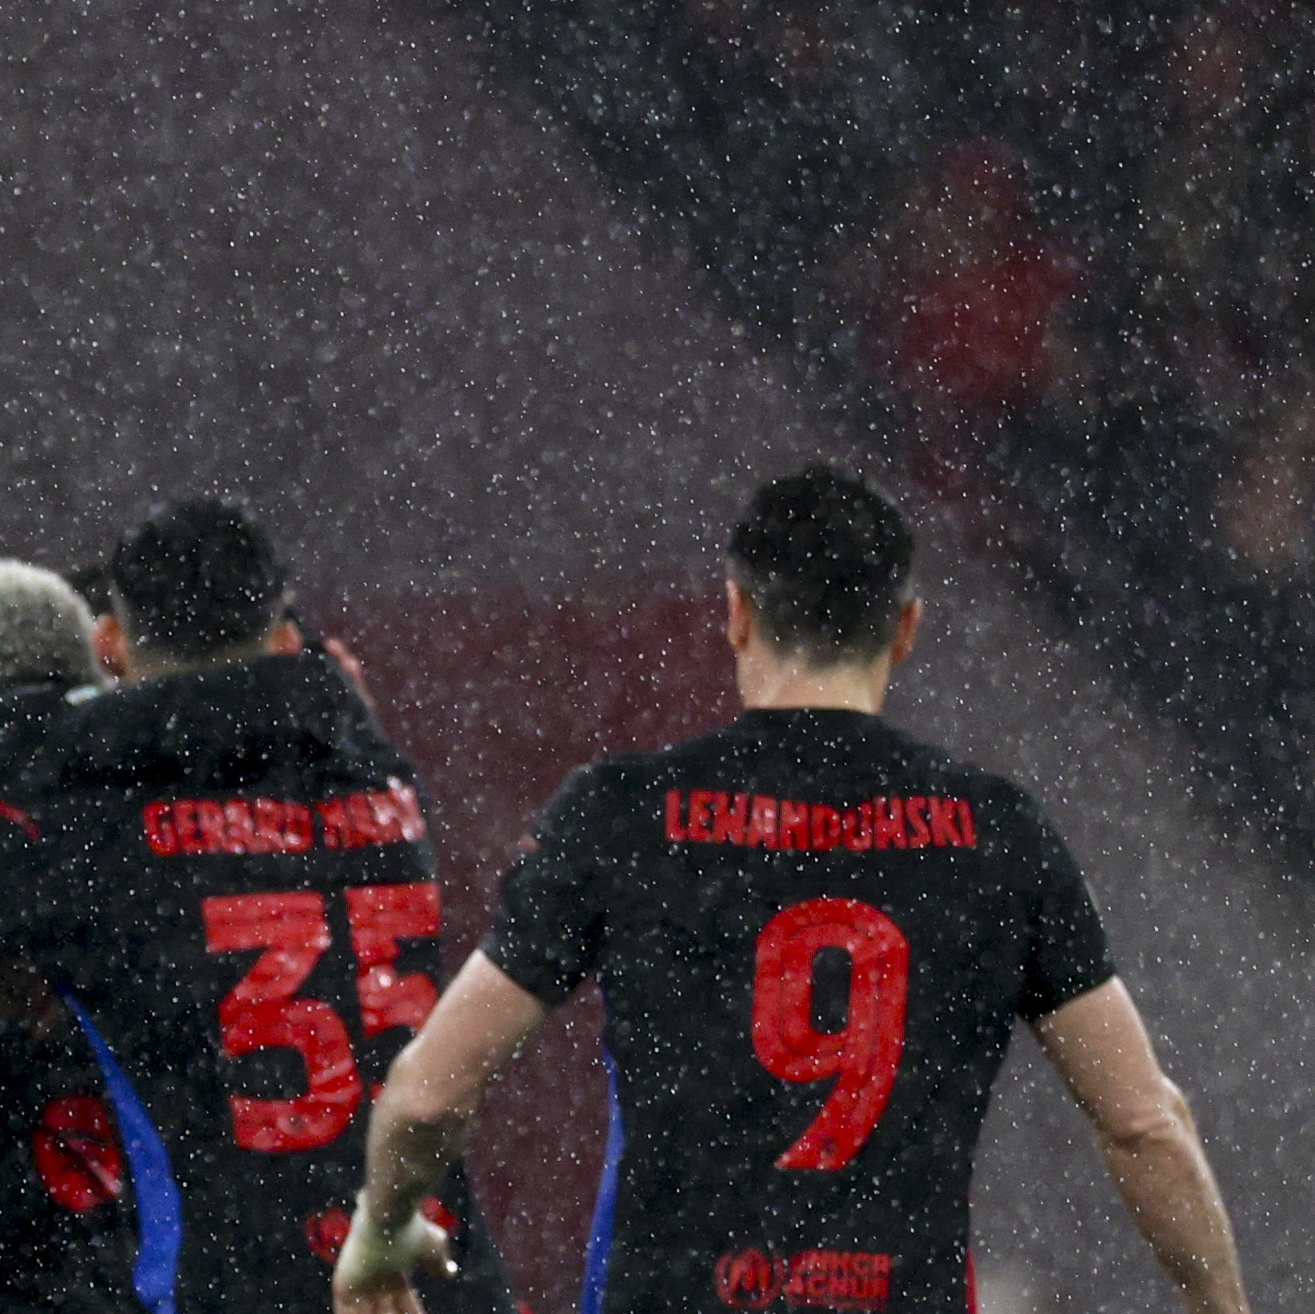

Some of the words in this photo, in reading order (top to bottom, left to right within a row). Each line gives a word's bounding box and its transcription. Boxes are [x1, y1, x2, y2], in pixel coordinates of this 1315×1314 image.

[665, 790, 977, 852] LEWANDOWSKI
[201, 882, 441, 1153] 35
[751, 898, 911, 1170] 9
